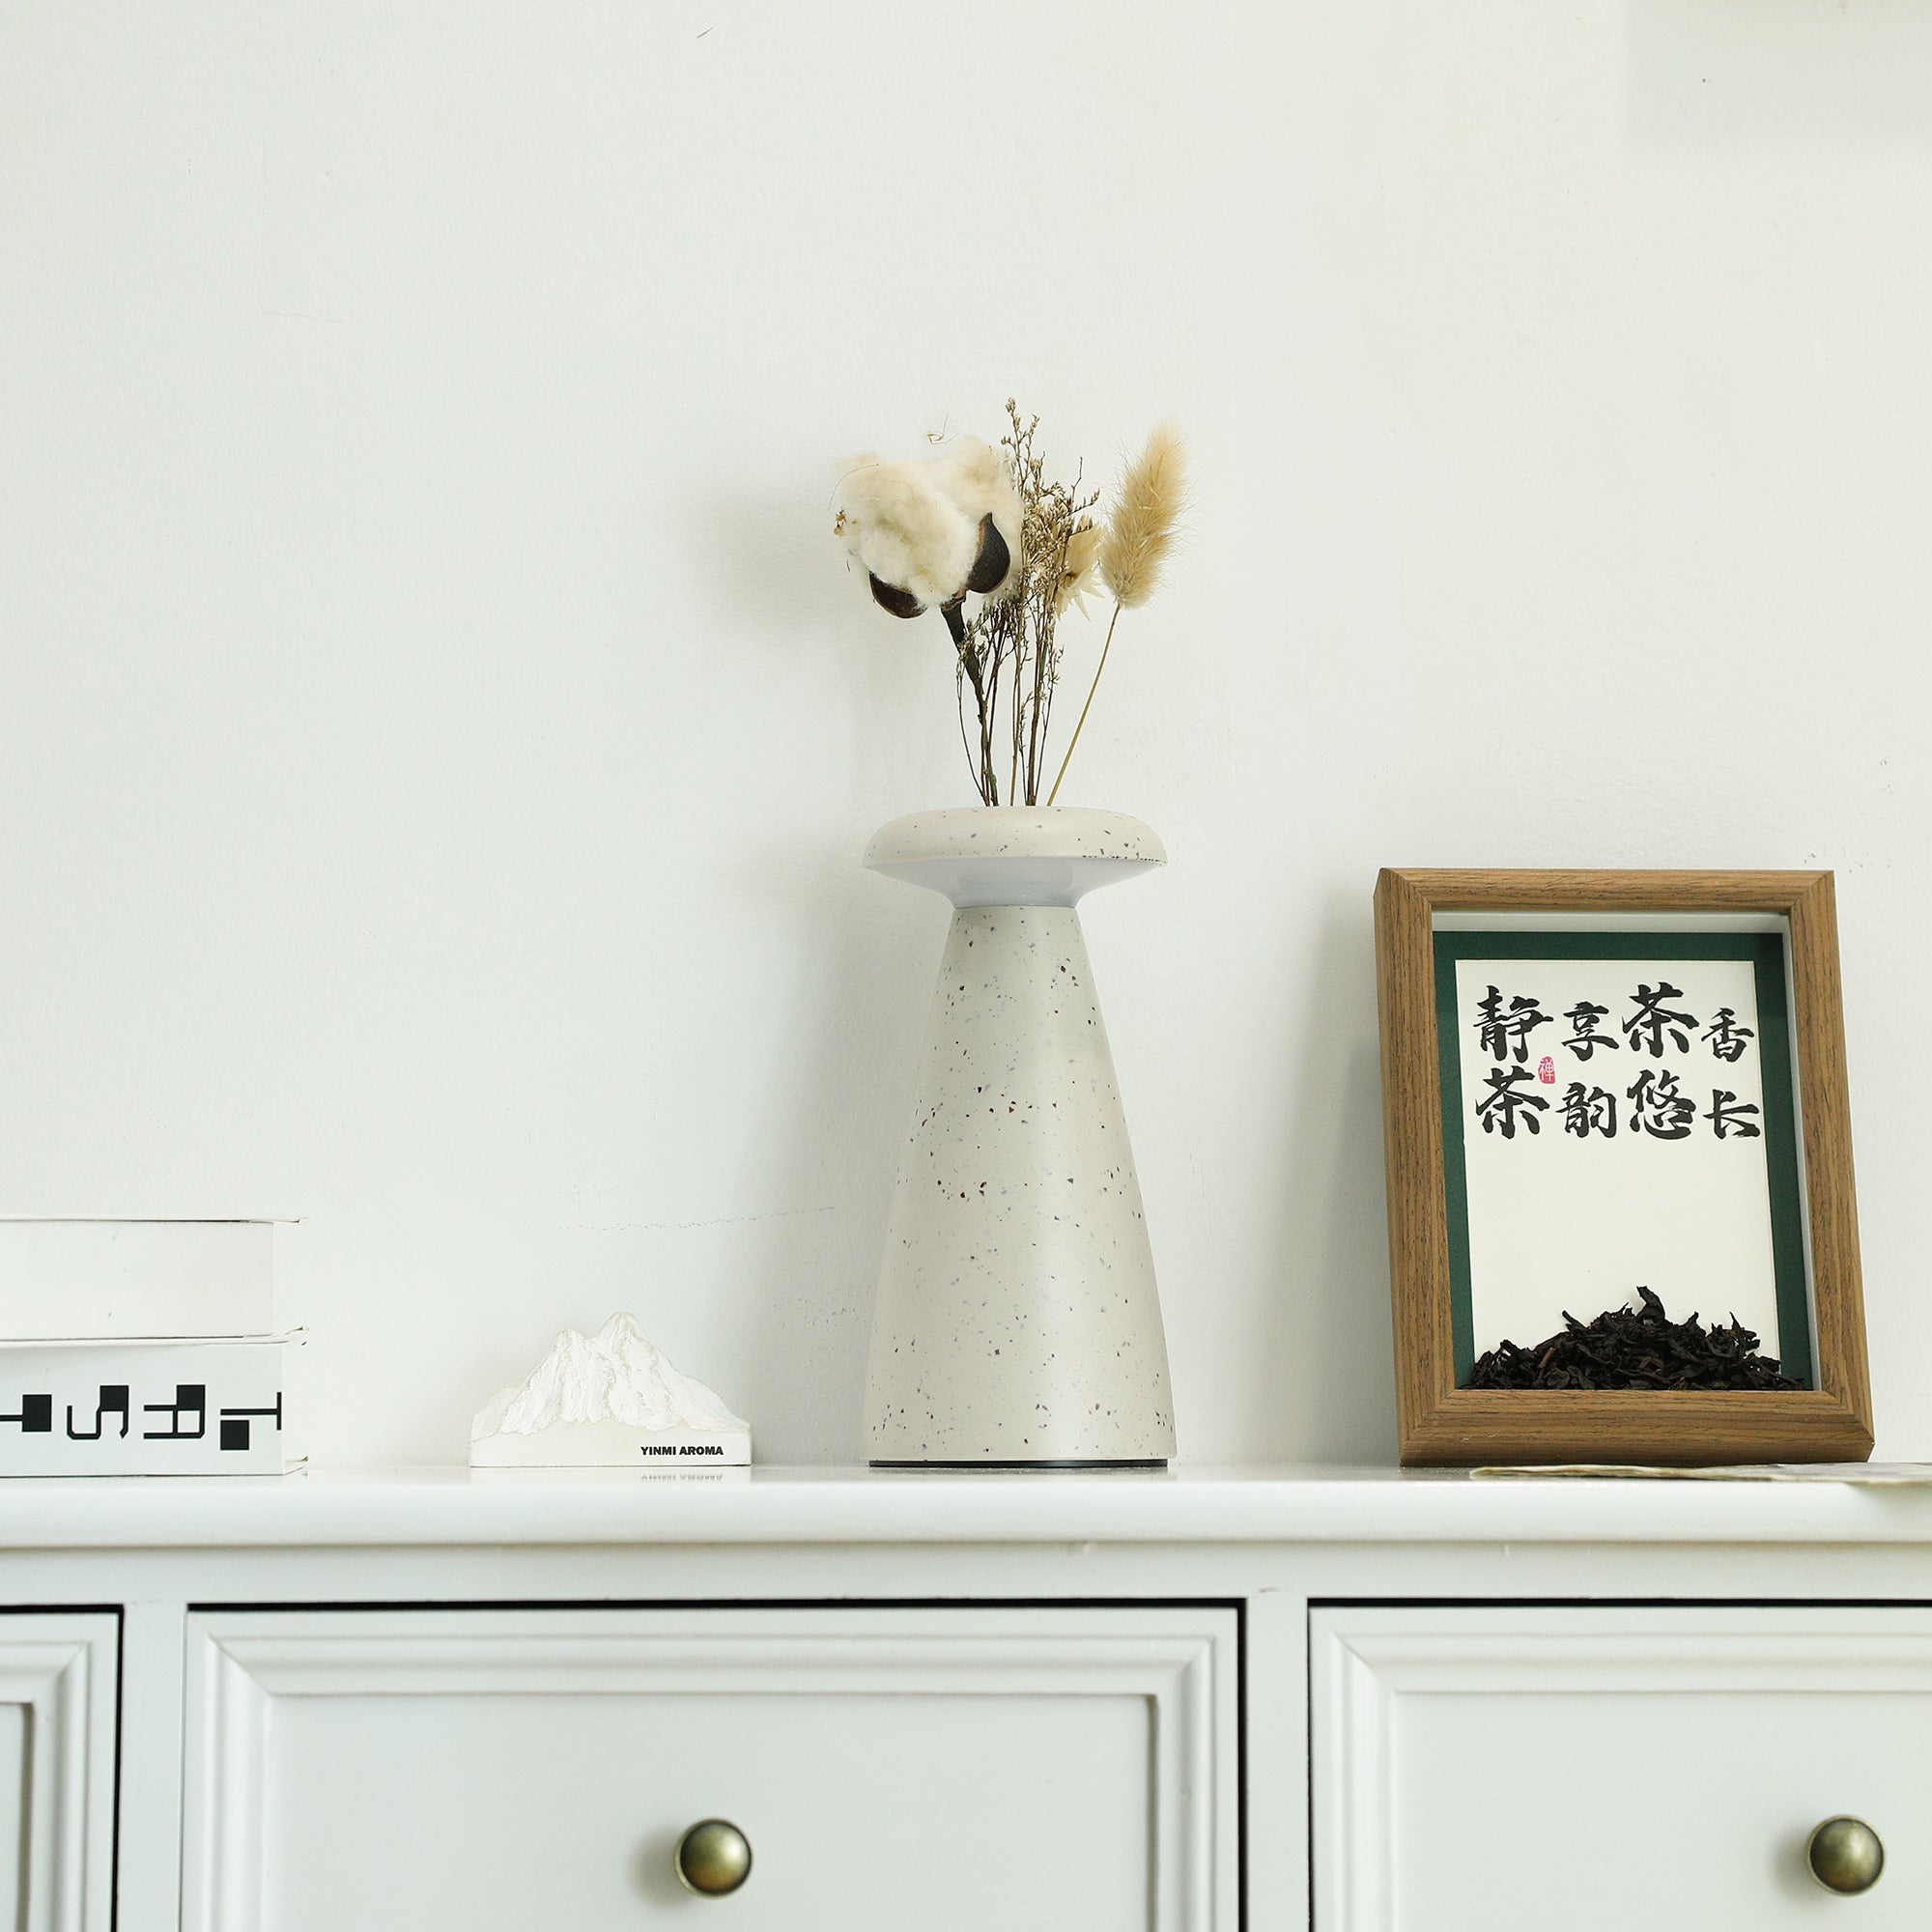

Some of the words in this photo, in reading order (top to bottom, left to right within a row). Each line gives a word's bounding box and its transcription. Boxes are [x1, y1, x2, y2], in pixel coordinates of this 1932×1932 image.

[1473, 981, 1754, 1063] 静享茶香
[1475, 1065, 1761, 1140] 茶韵悠长
[640, 1446, 676, 1456] YINMI
[679, 1446, 724, 1456] AROMA
